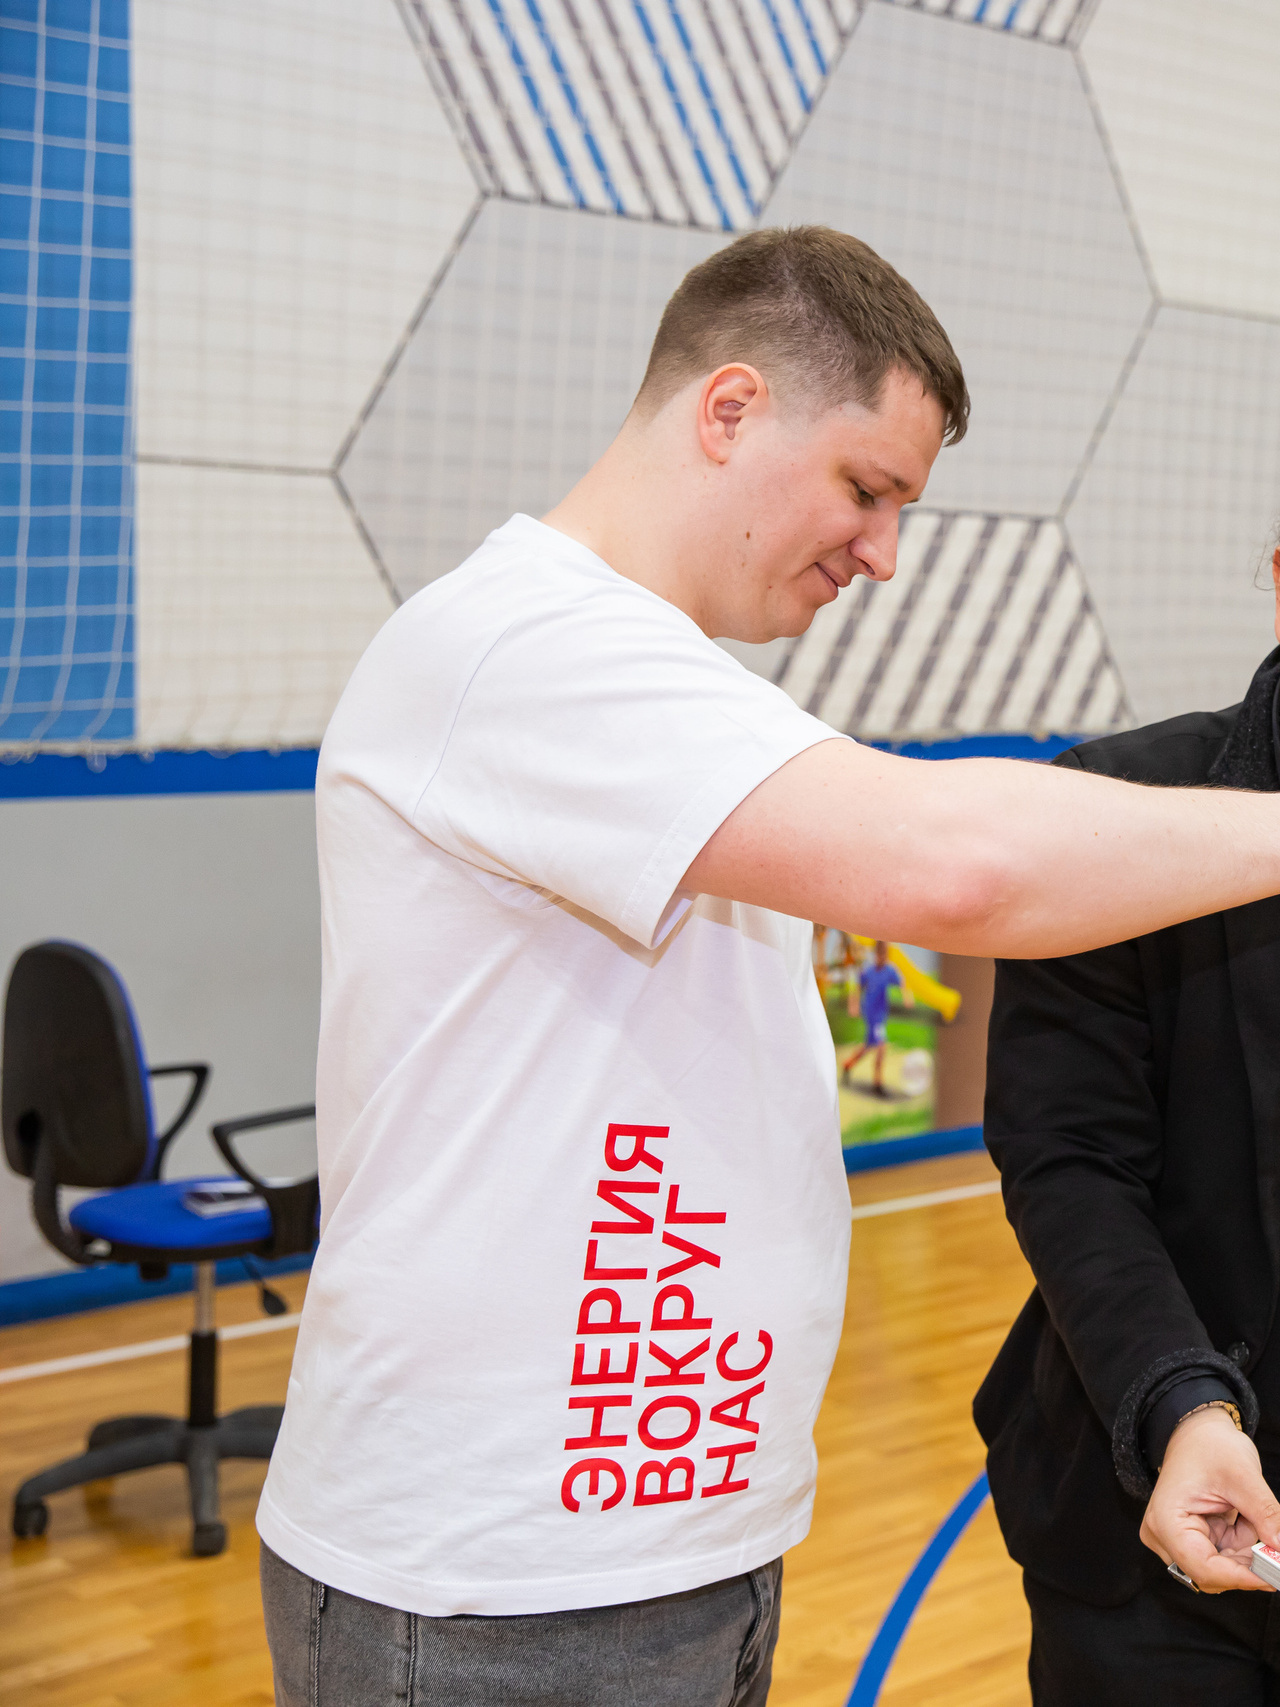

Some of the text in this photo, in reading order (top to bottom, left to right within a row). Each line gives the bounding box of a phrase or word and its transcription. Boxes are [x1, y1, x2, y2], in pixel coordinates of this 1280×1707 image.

[561, 1123, 670, 1513] ЭНЕРГИЯ
[633, 1184, 727, 1507] ВОКРУГ
[701, 1330, 774, 1499] НАС
